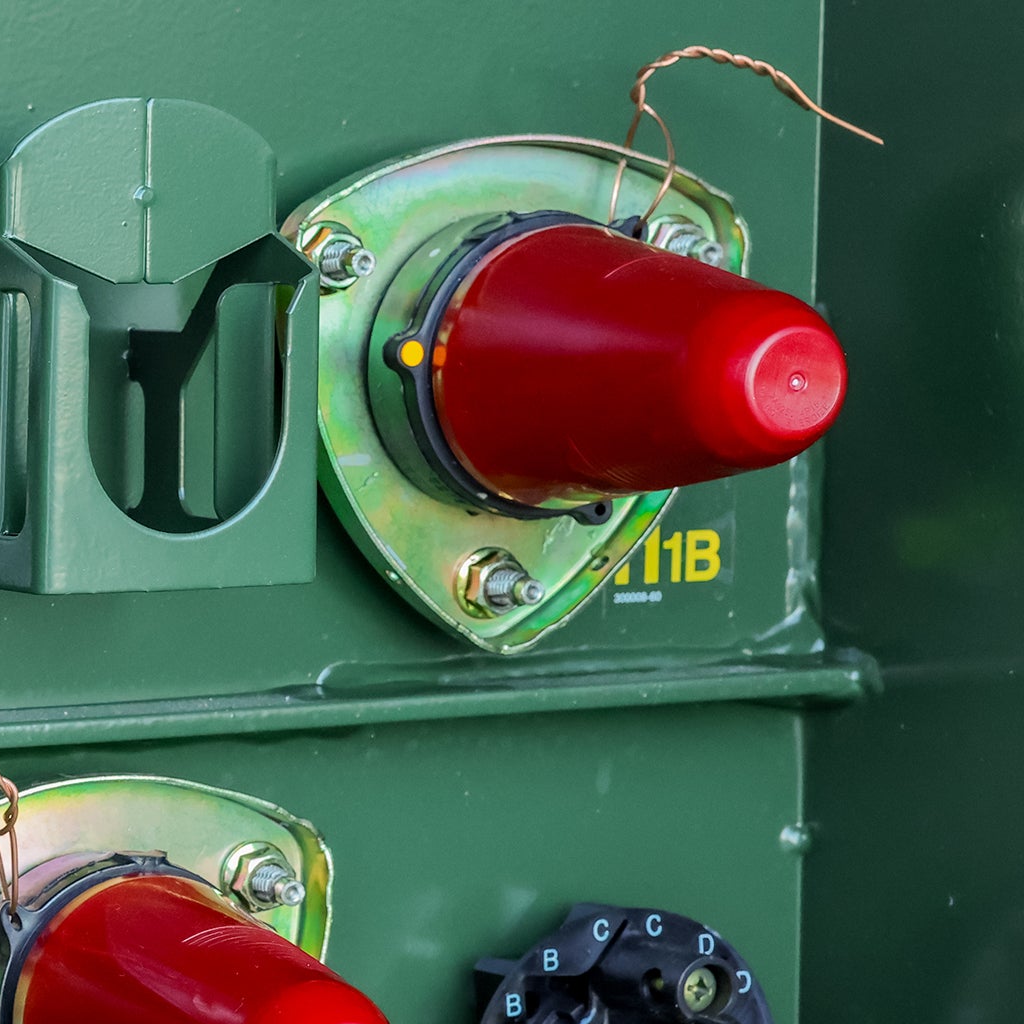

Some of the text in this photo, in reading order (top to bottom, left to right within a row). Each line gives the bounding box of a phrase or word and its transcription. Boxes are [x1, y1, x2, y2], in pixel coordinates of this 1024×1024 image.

[593, 919, 610, 942] C
[646, 914, 663, 937] C
[698, 934, 715, 956] D
[544, 949, 560, 972] B
[506, 993, 523, 1017] B
